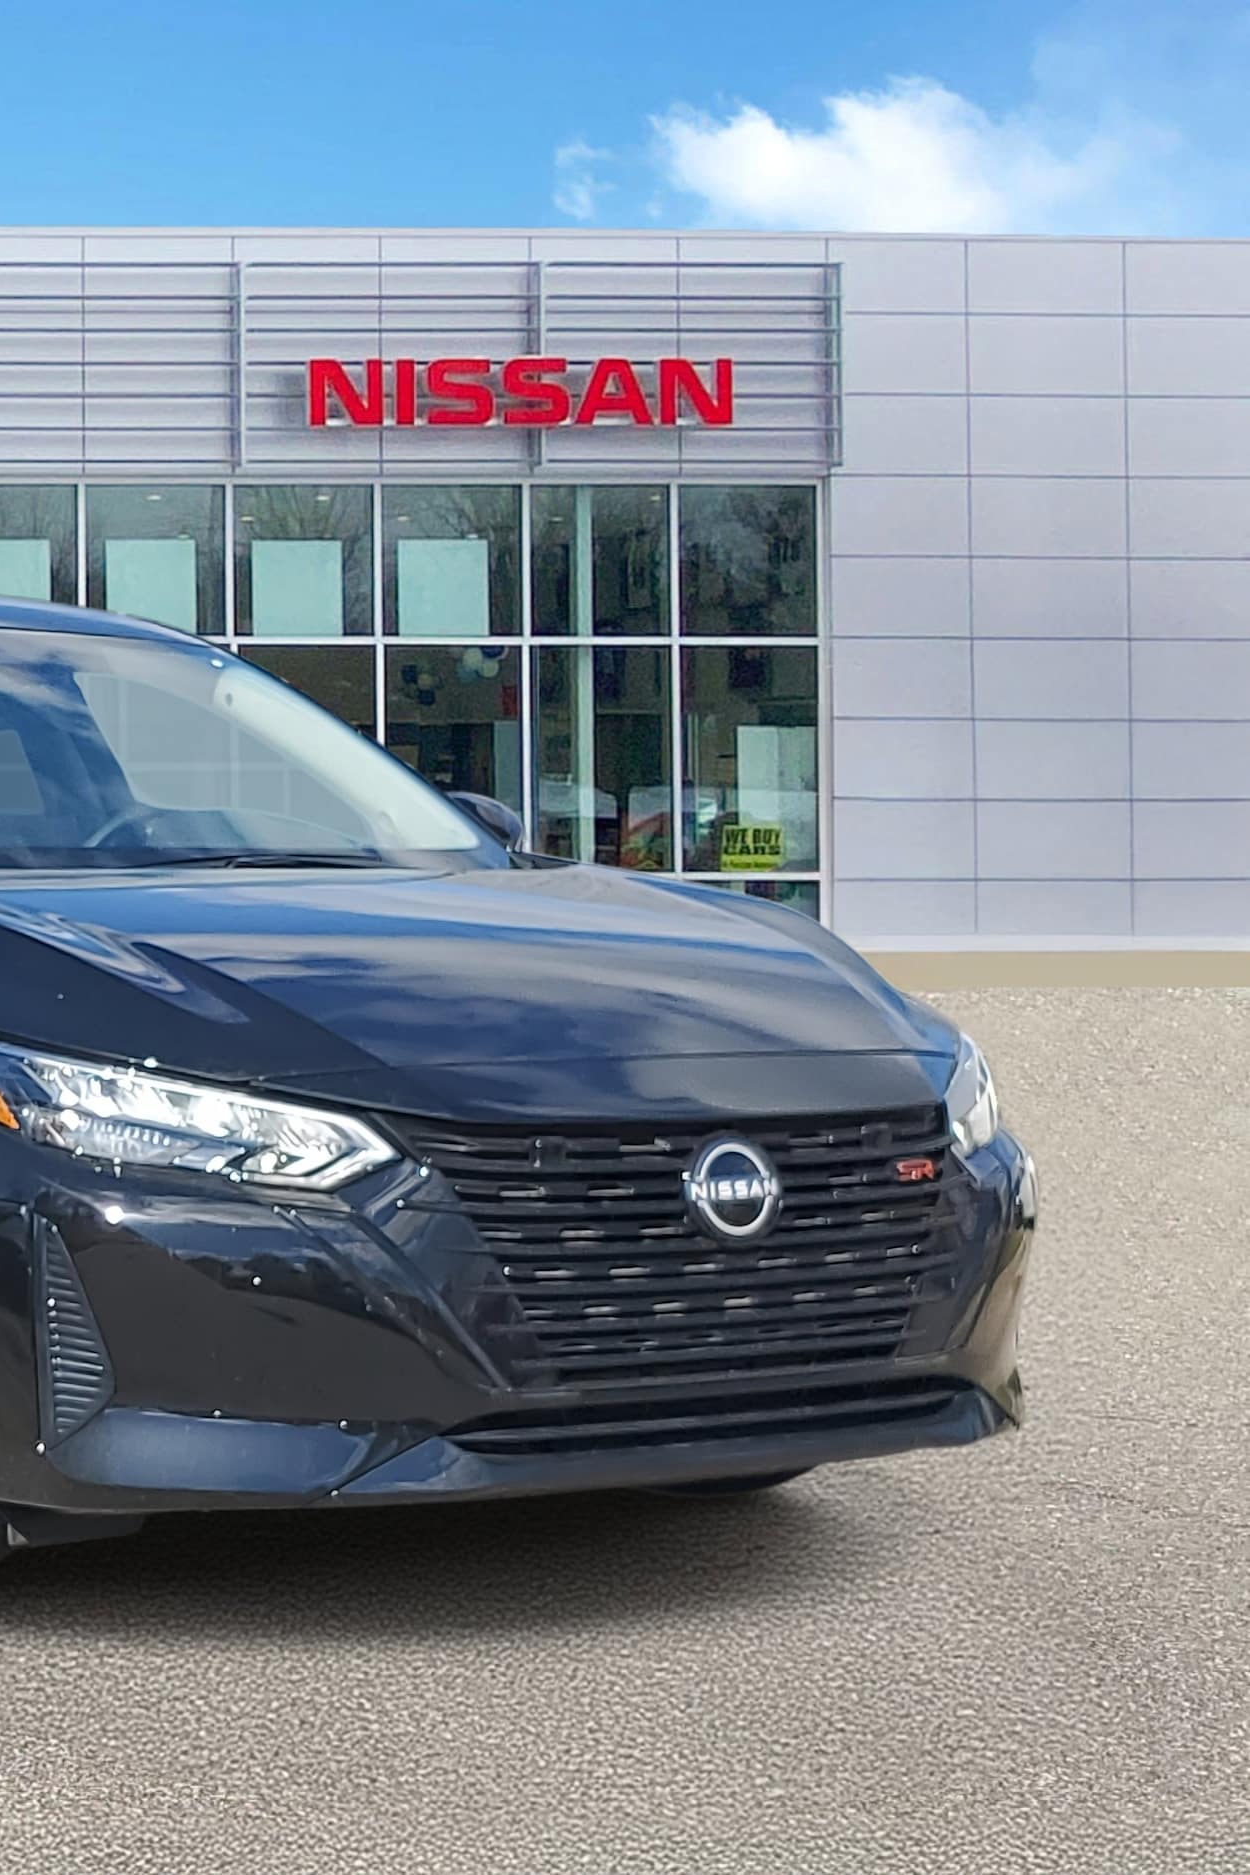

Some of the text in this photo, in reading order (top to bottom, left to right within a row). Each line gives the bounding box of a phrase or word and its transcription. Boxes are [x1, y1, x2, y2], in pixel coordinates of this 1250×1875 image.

[307, 357, 734, 427] NISSAN
[724, 828, 782, 846] WE BUY
[724, 845, 781, 855] CARS
[690, 1176, 779, 1201] NISSAN
